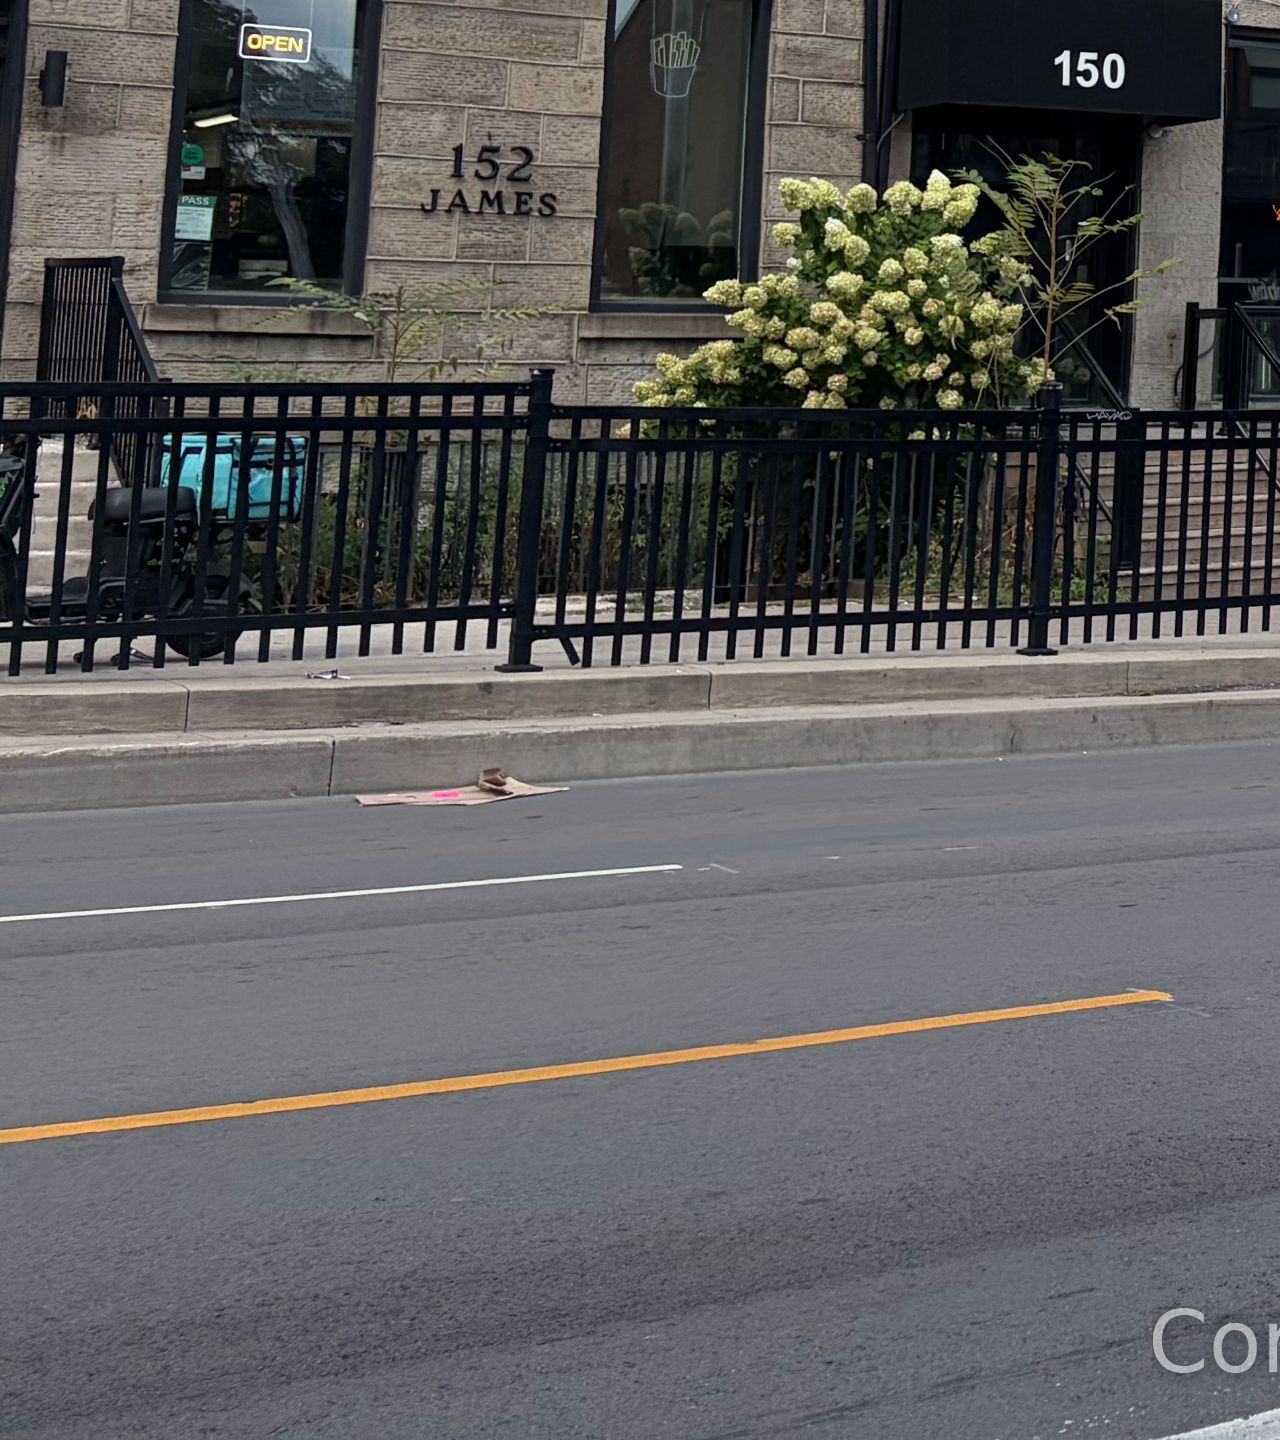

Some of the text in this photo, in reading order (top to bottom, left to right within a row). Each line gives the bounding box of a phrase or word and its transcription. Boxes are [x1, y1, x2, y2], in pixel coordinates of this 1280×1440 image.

[247, 33, 304, 53] OPEN
[1053, 50, 1126, 89] 150
[451, 143, 534, 182] 152
[182, 195, 210, 206] PASS
[420, 188, 558, 217] JAMES
